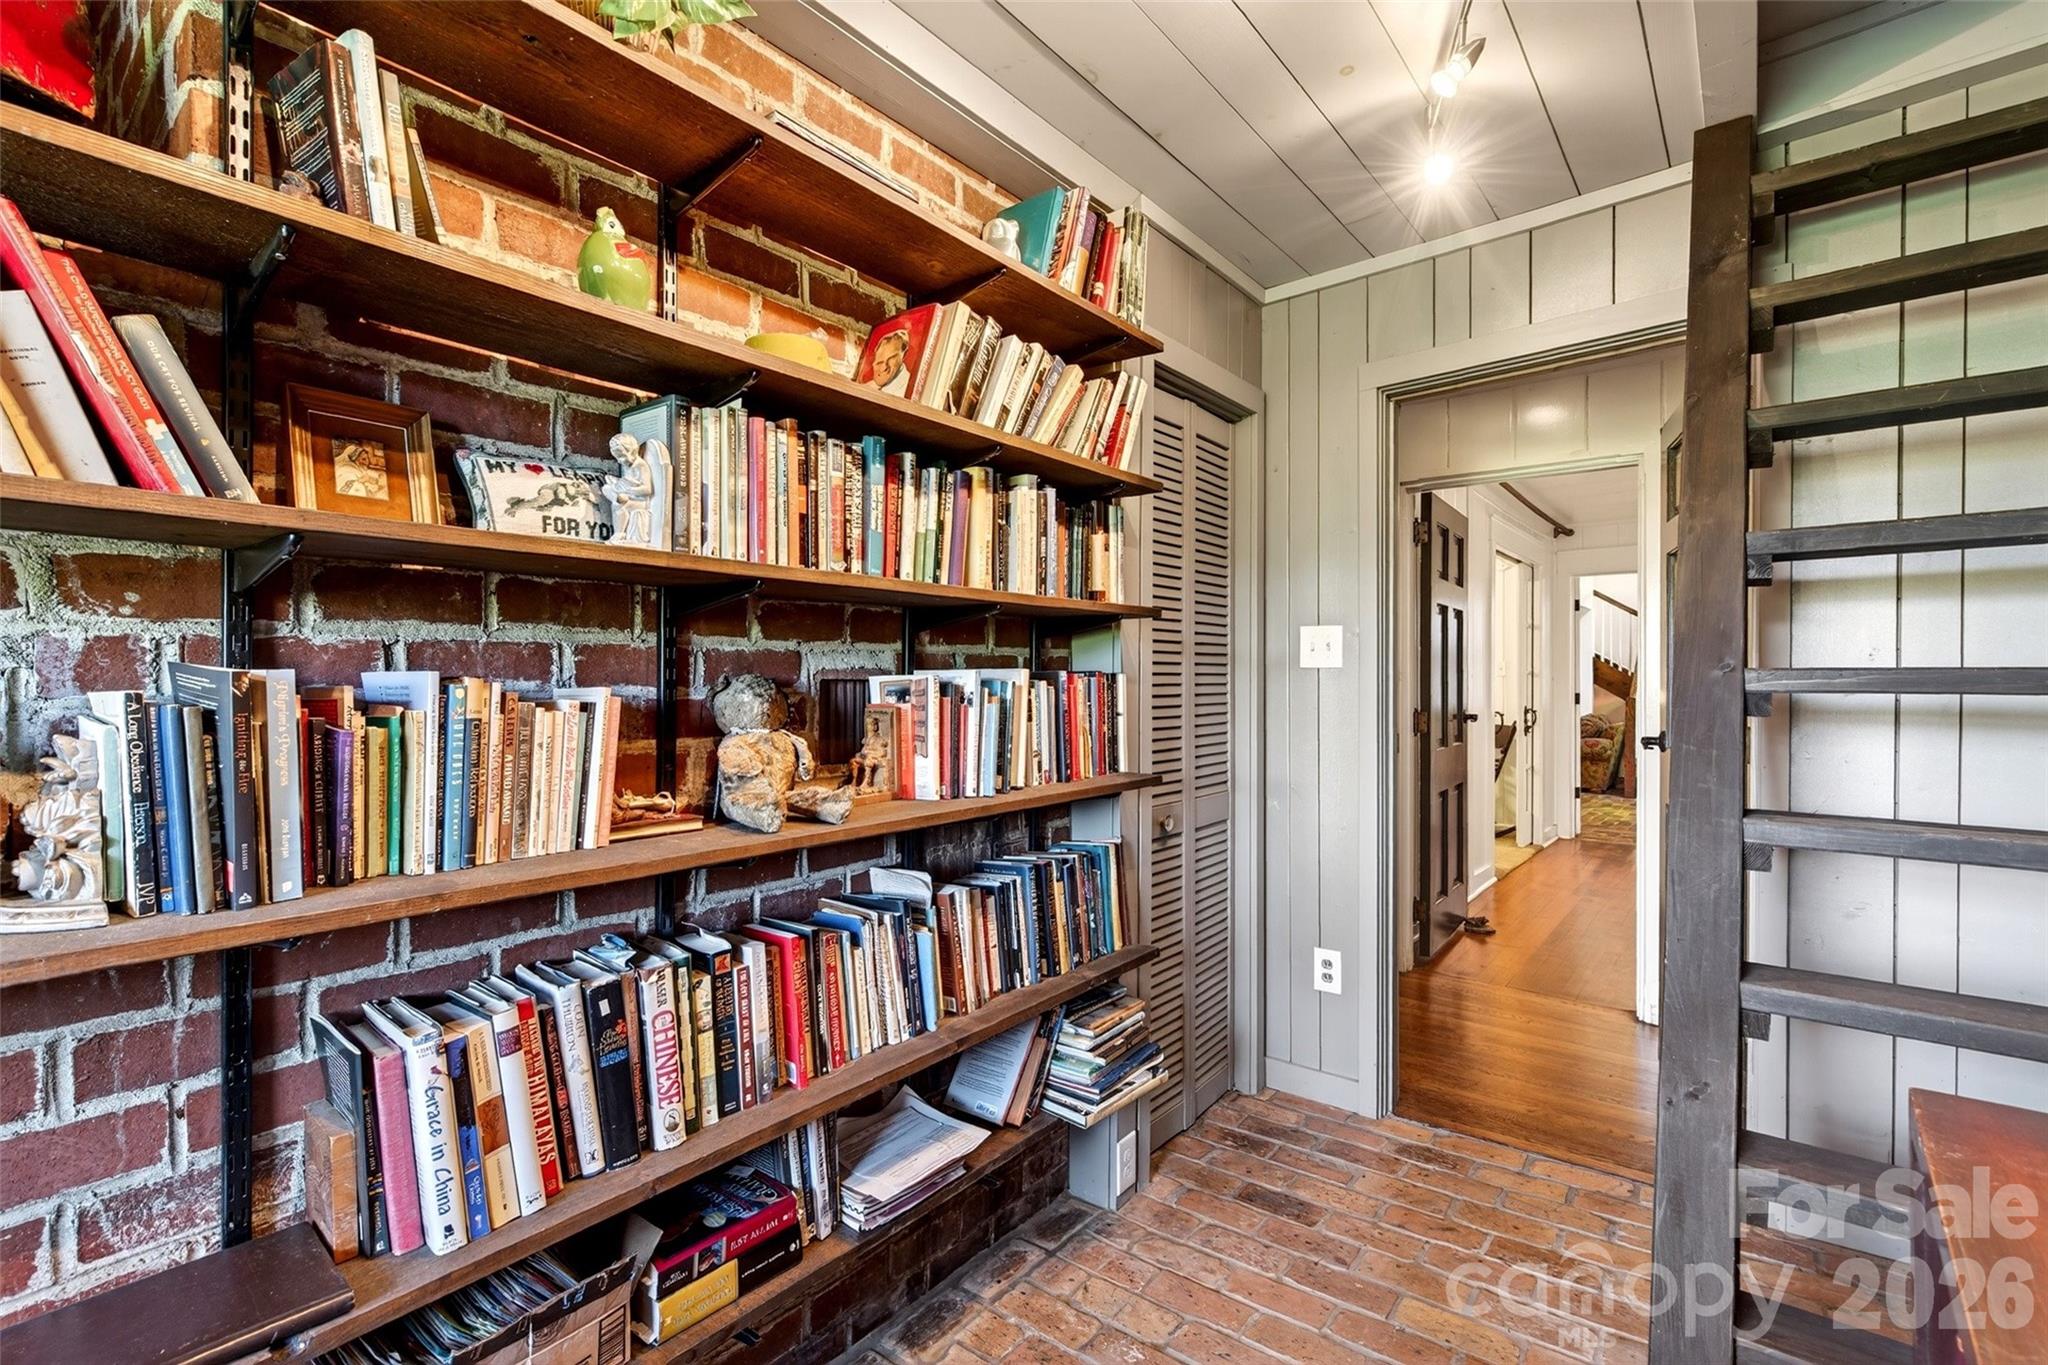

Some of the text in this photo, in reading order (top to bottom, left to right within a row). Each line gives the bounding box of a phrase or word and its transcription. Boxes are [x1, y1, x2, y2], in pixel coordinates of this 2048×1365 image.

[168, 378, 181, 396] FOR
[179, 398, 200, 432] REVIVAL
[485, 459, 517, 474] MY
[541, 515, 580, 537] FOR
[125, 701, 146, 793] A Long Obedience
[233, 712, 249, 758] Igniting
[505, 717, 514, 747] LEWIS
[237, 772, 250, 794] Fire
[137, 882, 155, 904] IVP
[651, 1009, 681, 1109] CHINESE
[528, 1074, 556, 1165] HIMALAYAS
[425, 1084, 455, 1216] Grace in China
